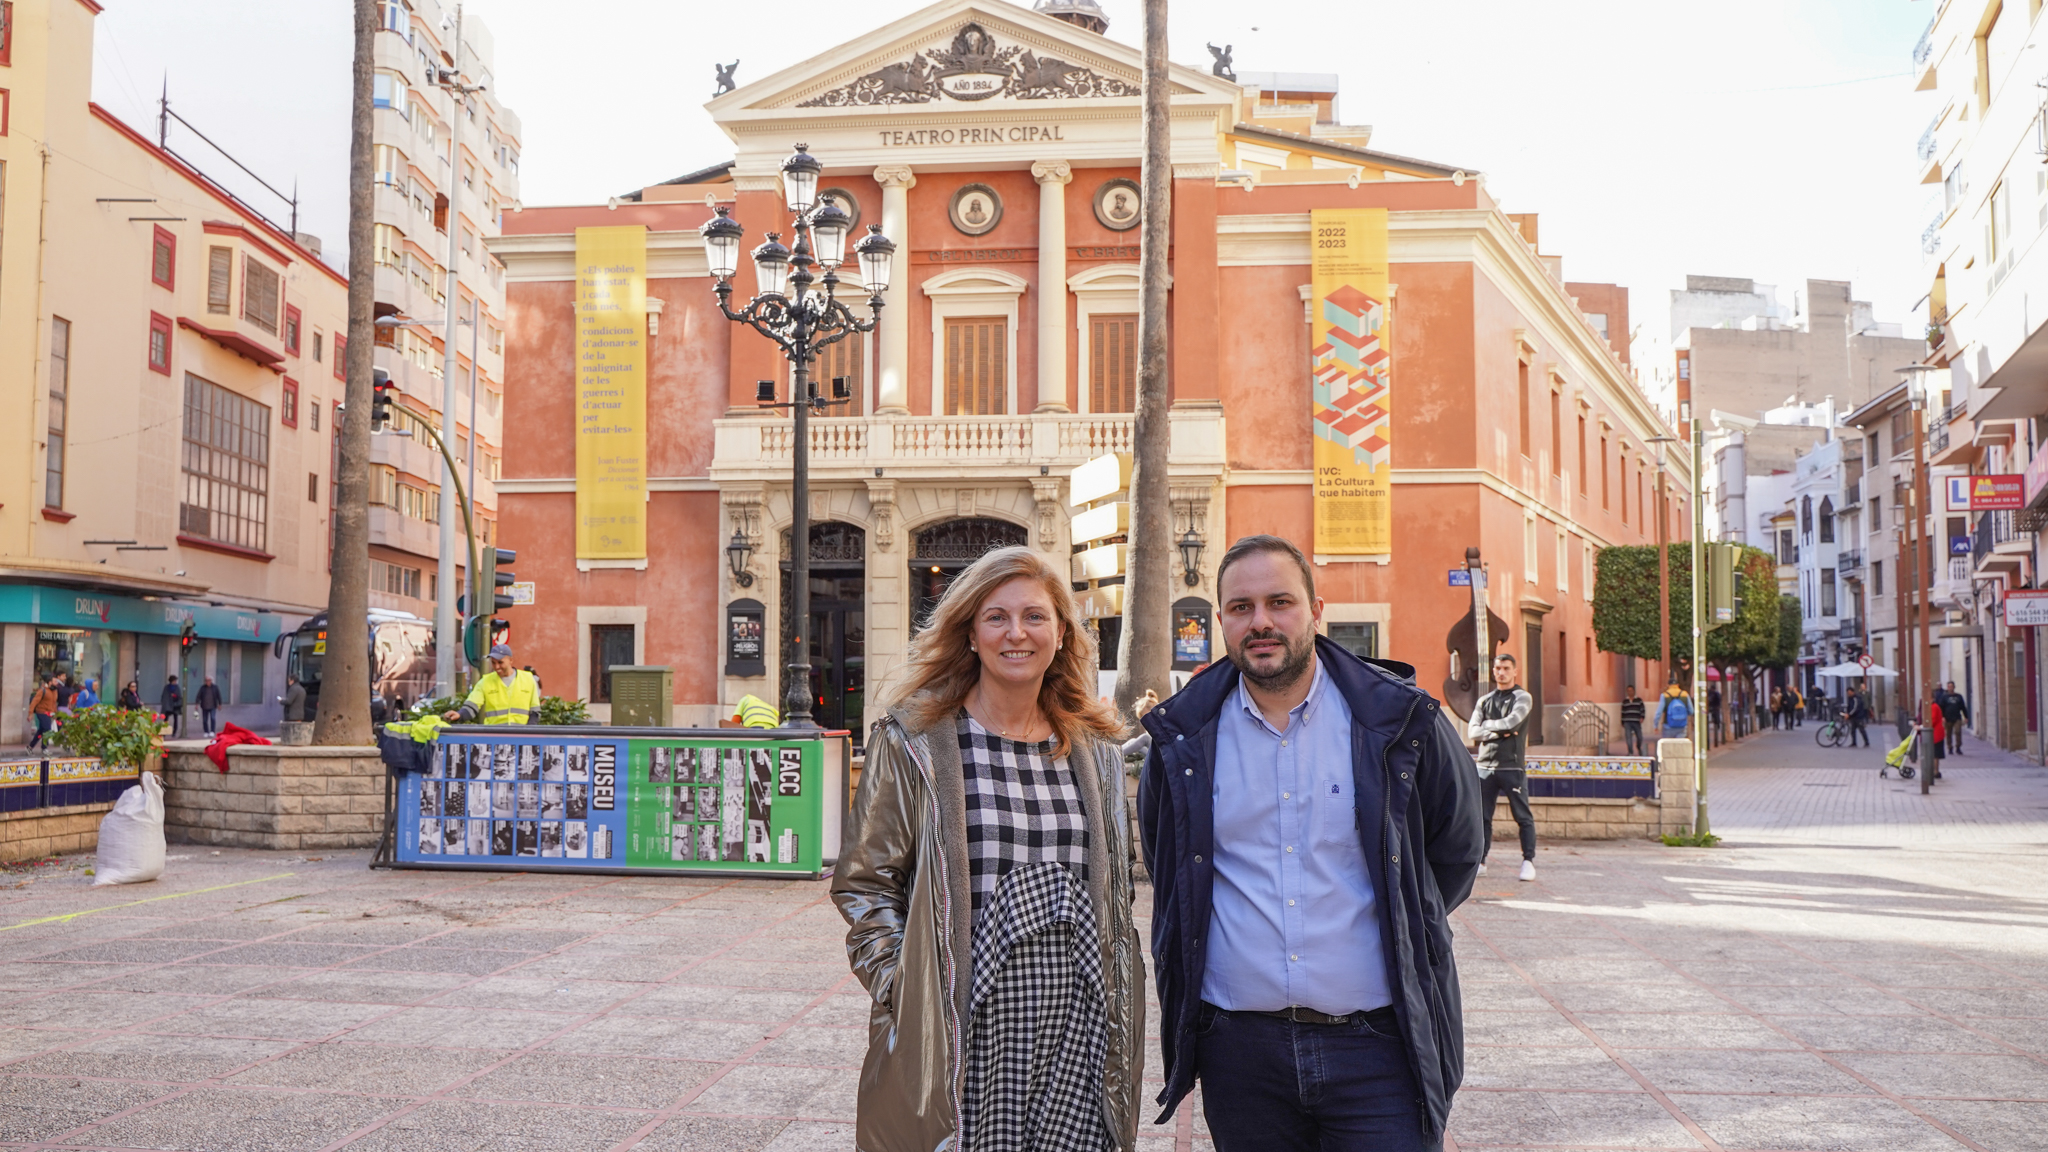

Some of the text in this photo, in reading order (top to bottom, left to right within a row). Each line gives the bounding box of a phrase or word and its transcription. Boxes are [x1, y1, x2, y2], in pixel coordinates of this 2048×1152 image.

[953, 80, 993, 91] AÑO 1894
[879, 129, 955, 146] TEATRO
[1318, 228, 1346, 237] 2022
[1318, 239, 1346, 248] 2023
[604, 265, 635, 275] pobles
[582, 278, 630, 287] han estat,
[588, 290, 610, 298] cada
[582, 302, 597, 310] dia
[582, 326, 634, 336] condicions
[582, 351, 606, 360] de la
[582, 363, 632, 374] malignitat
[582, 376, 610, 384] de les
[582, 390, 618, 399] guerres
[582, 401, 622, 409] d'actuar
[582, 415, 598, 423] per
[598, 456, 614, 465] Joan
[1319, 467, 1341, 476] IVC:
[1319, 478, 1374, 486] La Cultura
[1319, 488, 1386, 498] que habitem
[1952, 480, 1967, 503] L
[1954, 542, 1969, 550] AXA
[779, 749, 800, 794] EACC
[593, 746, 615, 808] MUSEU
